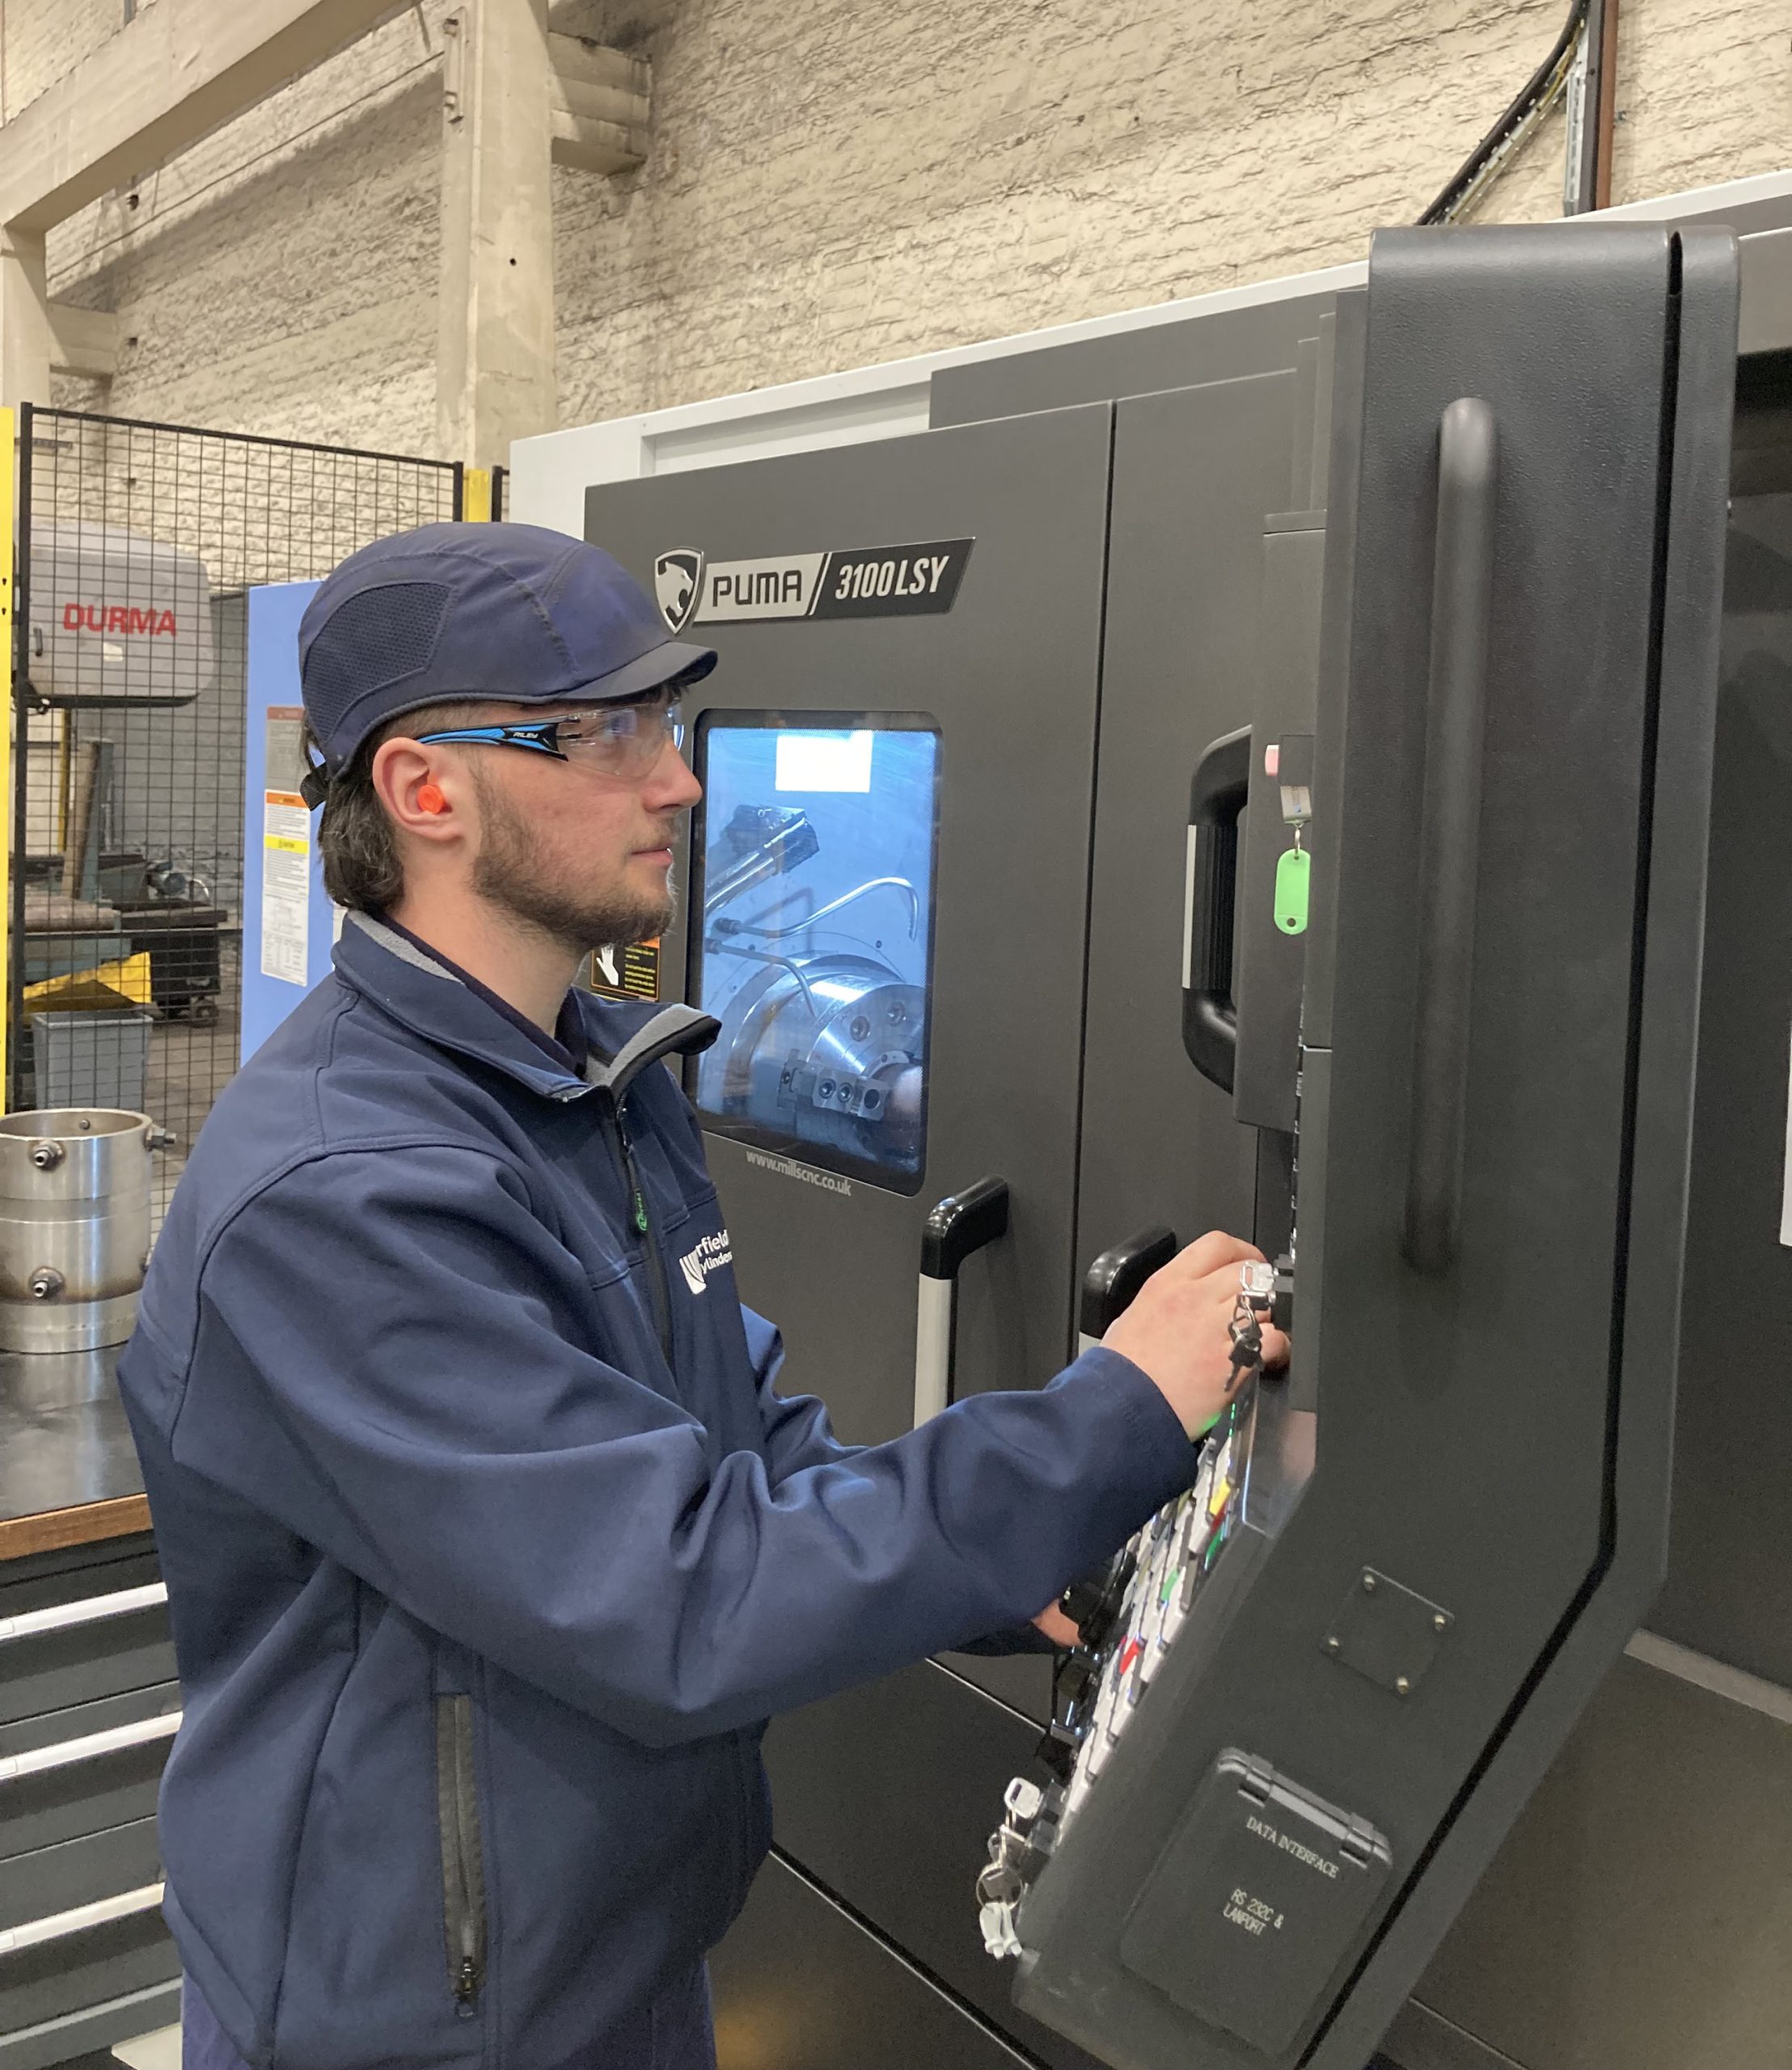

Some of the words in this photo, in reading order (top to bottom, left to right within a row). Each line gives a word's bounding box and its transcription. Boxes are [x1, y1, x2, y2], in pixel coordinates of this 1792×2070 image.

[712, 569, 802, 607] PUMA
[64, 602, 176, 637] DURMA
[746, 1151, 852, 1197] www.millscnc.co.uk
[1246, 1815, 1278, 1842] DATA
[1278, 1836, 1339, 1879] INTERFACE
[1223, 1902, 1267, 1936] LANPORT
[1231, 1888, 1247, 1905] RS
[1247, 1898, 1274, 1921] 232C
[1274, 1914, 1284, 1929] &
